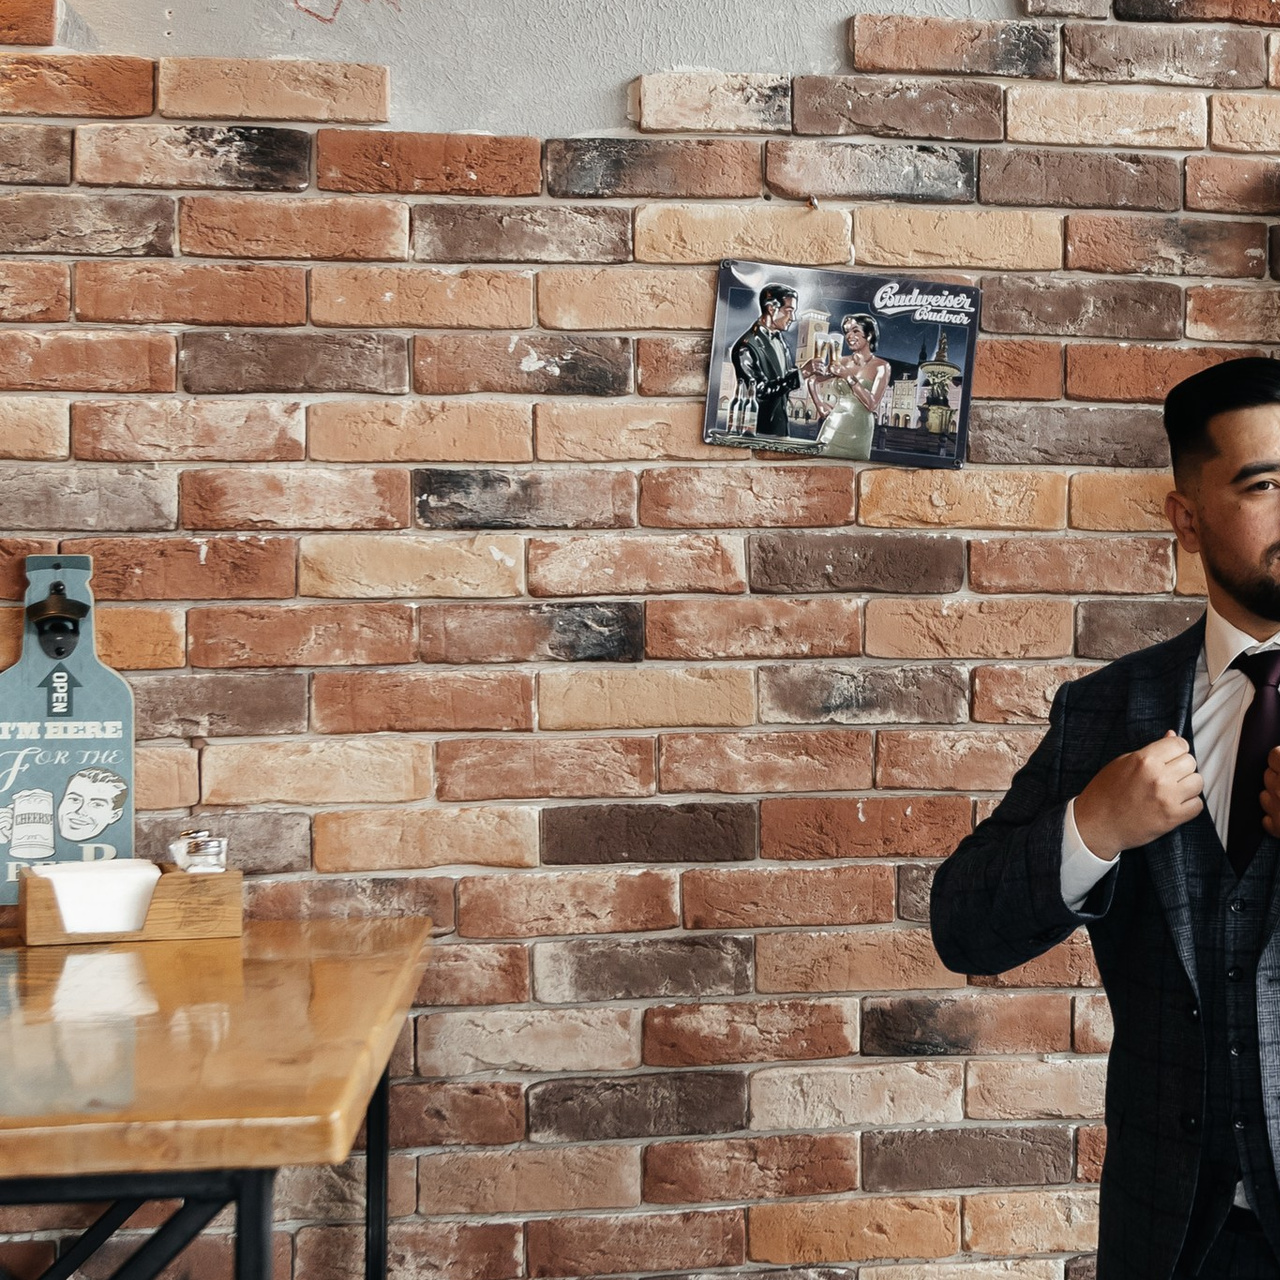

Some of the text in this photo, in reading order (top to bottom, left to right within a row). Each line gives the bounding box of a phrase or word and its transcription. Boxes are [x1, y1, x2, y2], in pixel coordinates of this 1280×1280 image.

[874, 283, 975, 312] Budweiser
[914, 305, 971, 325] Budvar
[52, 671, 68, 713] OPEN
[0, 721, 122, 739] I'M HERE
